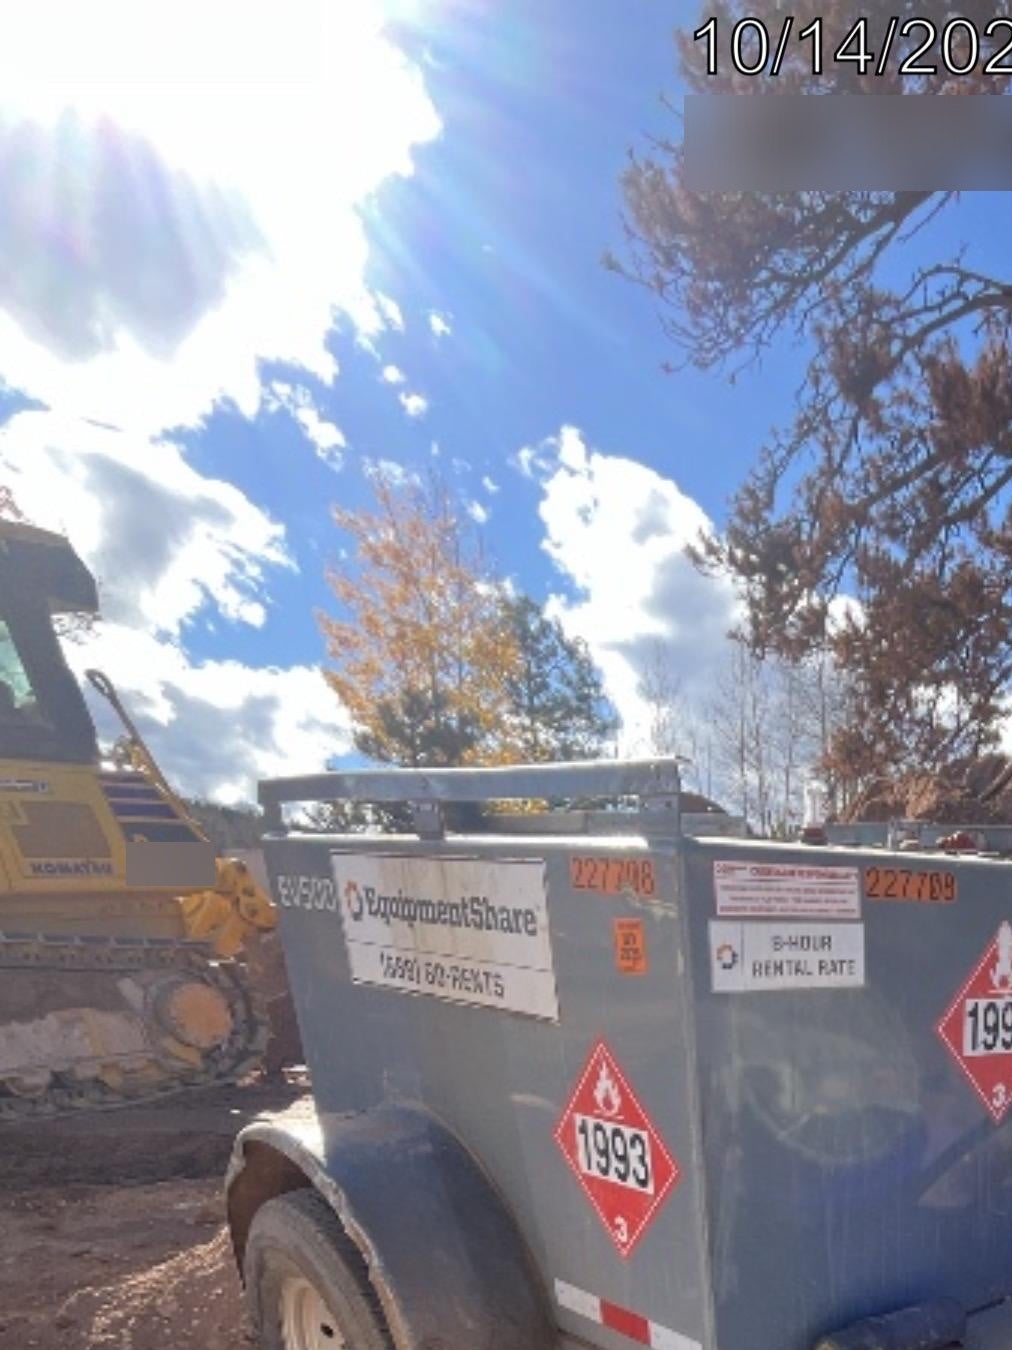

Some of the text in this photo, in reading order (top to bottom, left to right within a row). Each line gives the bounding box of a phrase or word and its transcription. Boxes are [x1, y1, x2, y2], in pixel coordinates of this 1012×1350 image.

[362, 887, 539, 936] EquipmentShare
[751, 959, 857, 978] RENTAL RATE
[992, 1084, 1007, 1107] 3
[578, 1118, 649, 1189] 1993
[614, 1214, 628, 1243] 3
